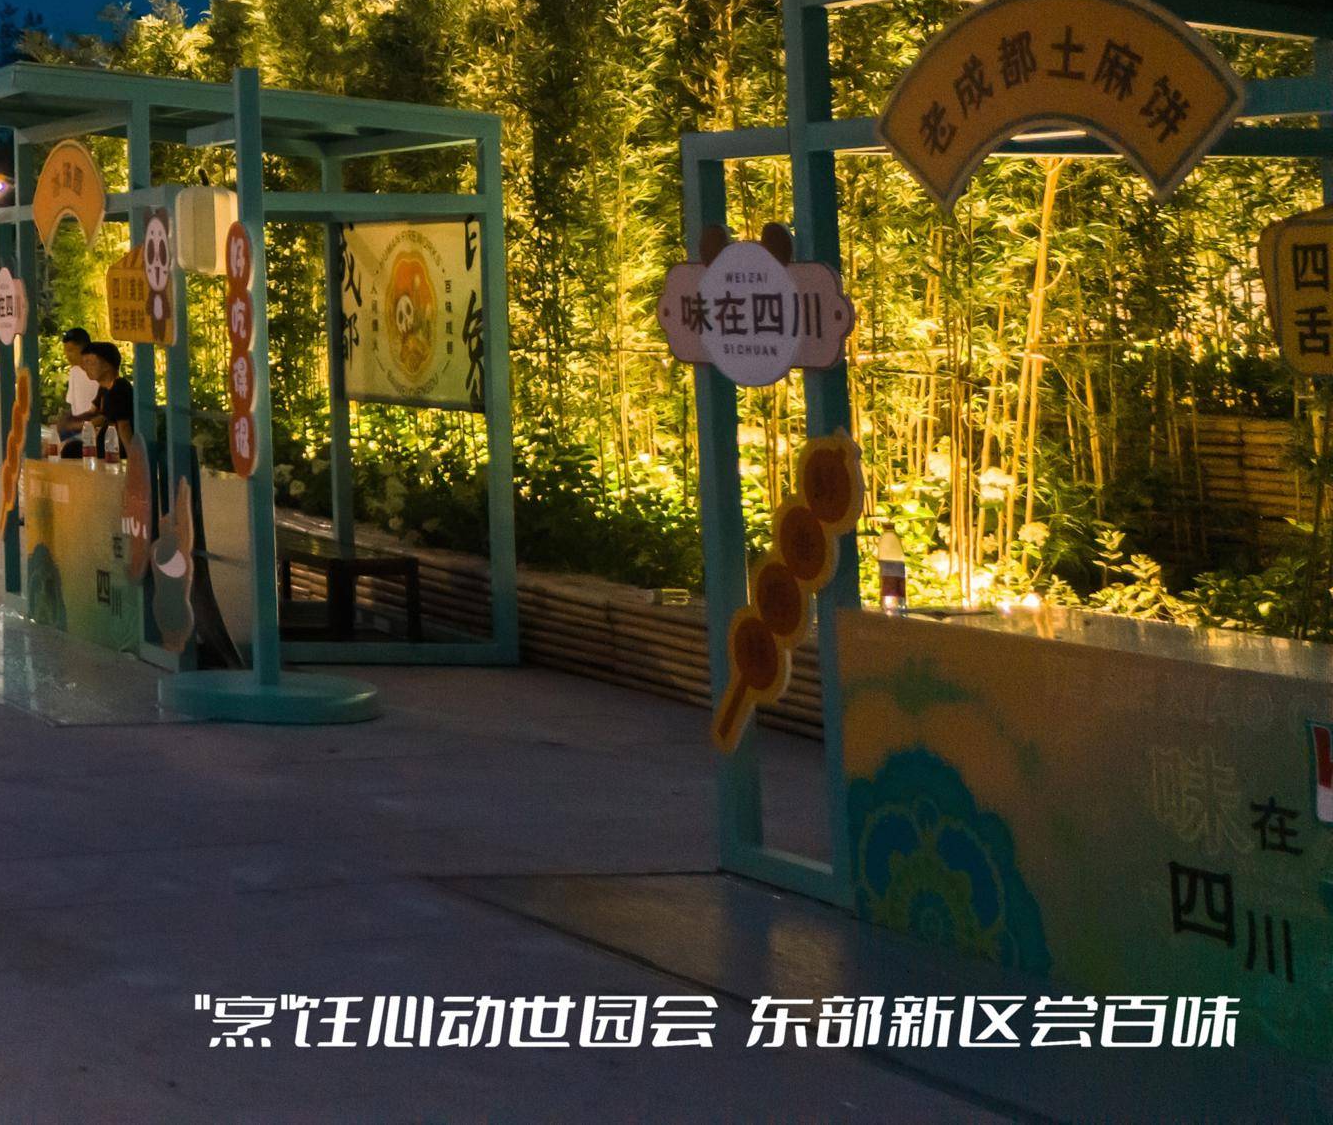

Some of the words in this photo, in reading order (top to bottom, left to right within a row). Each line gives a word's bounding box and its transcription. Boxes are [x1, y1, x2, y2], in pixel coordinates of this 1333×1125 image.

[919, 26, 1190, 155] 老成都土麻饼
[726, 272, 768, 284] WEIZAI
[681, 291, 822, 339] 味在四川
[723, 344, 778, 357] SICHUAN
